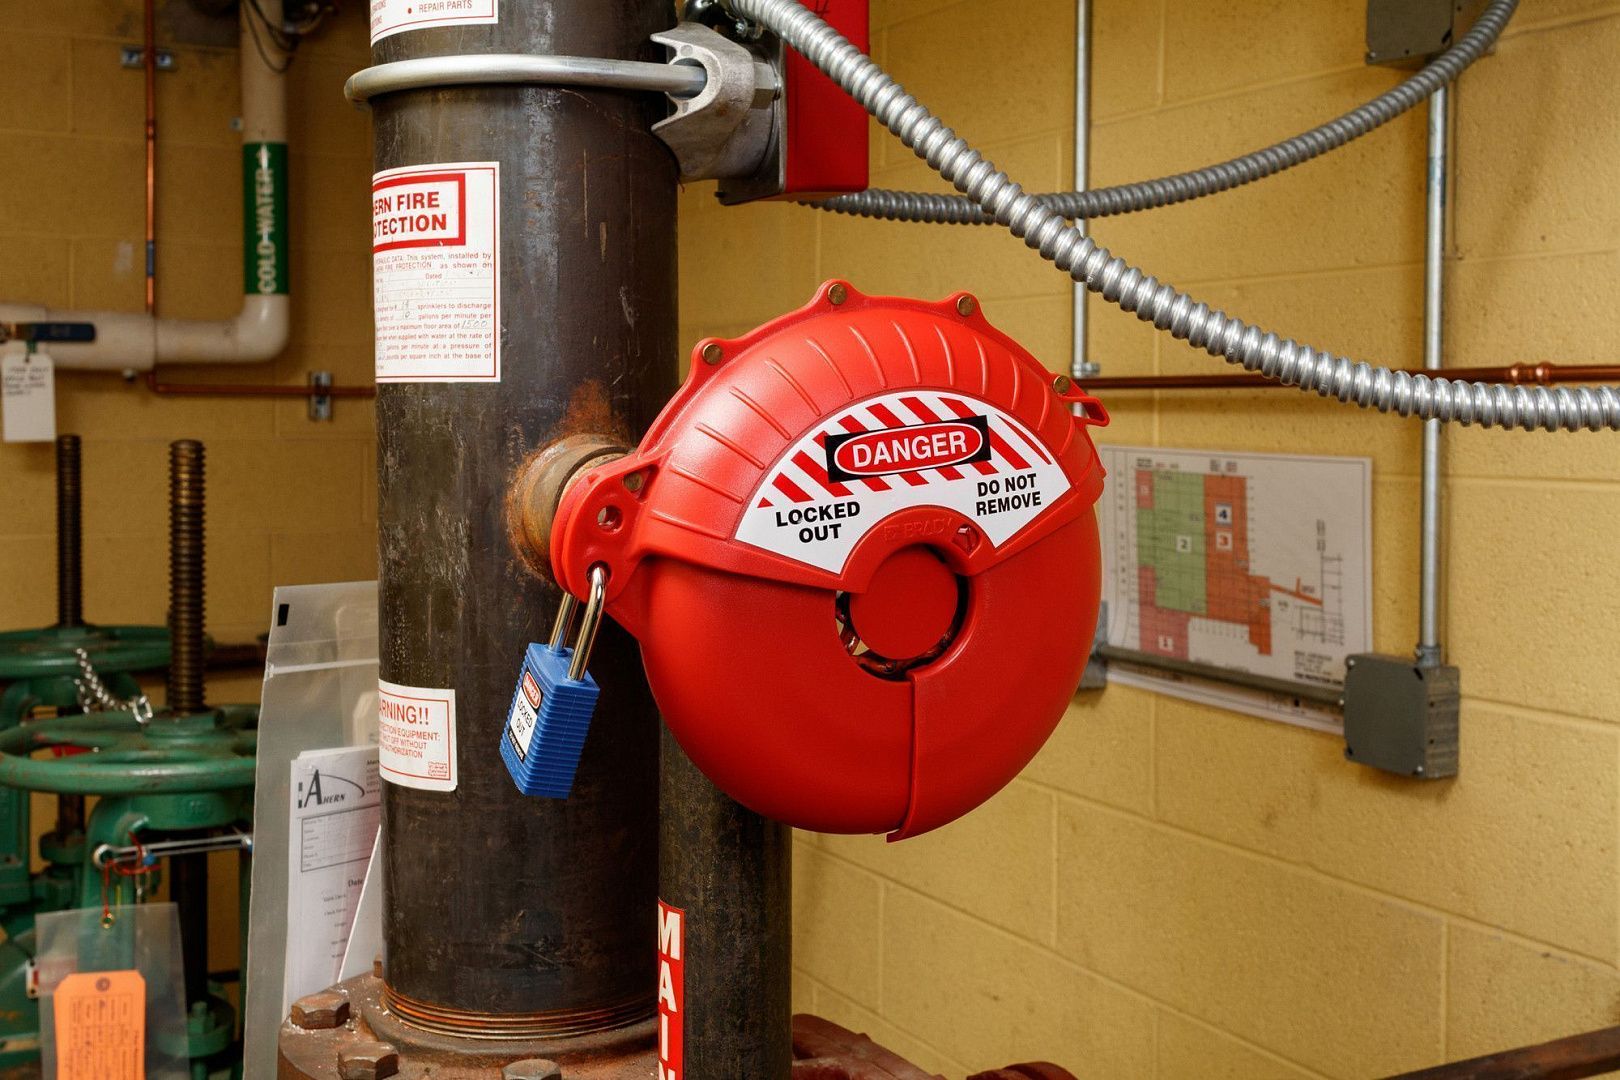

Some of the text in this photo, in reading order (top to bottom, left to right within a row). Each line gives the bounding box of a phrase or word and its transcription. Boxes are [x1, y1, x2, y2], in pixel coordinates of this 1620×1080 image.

[419, 0, 472, 13] REPAIR PARTS
[397, 191, 440, 211] FIRE
[255, 167, 277, 294] COLD WATER
[448, 252, 479, 260] installed
[482, 252, 492, 260] by
[395, 261, 432, 270] PROTECTION
[417, 303, 447, 311] sprinklers
[457, 302, 492, 310] discharge
[852, 430, 967, 468] DANGER
[977, 473, 1037, 498] DO NOT
[976, 491, 1042, 516] REMOVE
[775, 501, 861, 527] LOCKED
[1218, 508, 1228, 521] 4
[798, 523, 842, 543] OUT
[1218, 534, 1229, 547] 3
[1180, 538, 1188, 550] 2
[400, 739, 427, 750] WITHOUT
[304, 769, 346, 808] AHERN
